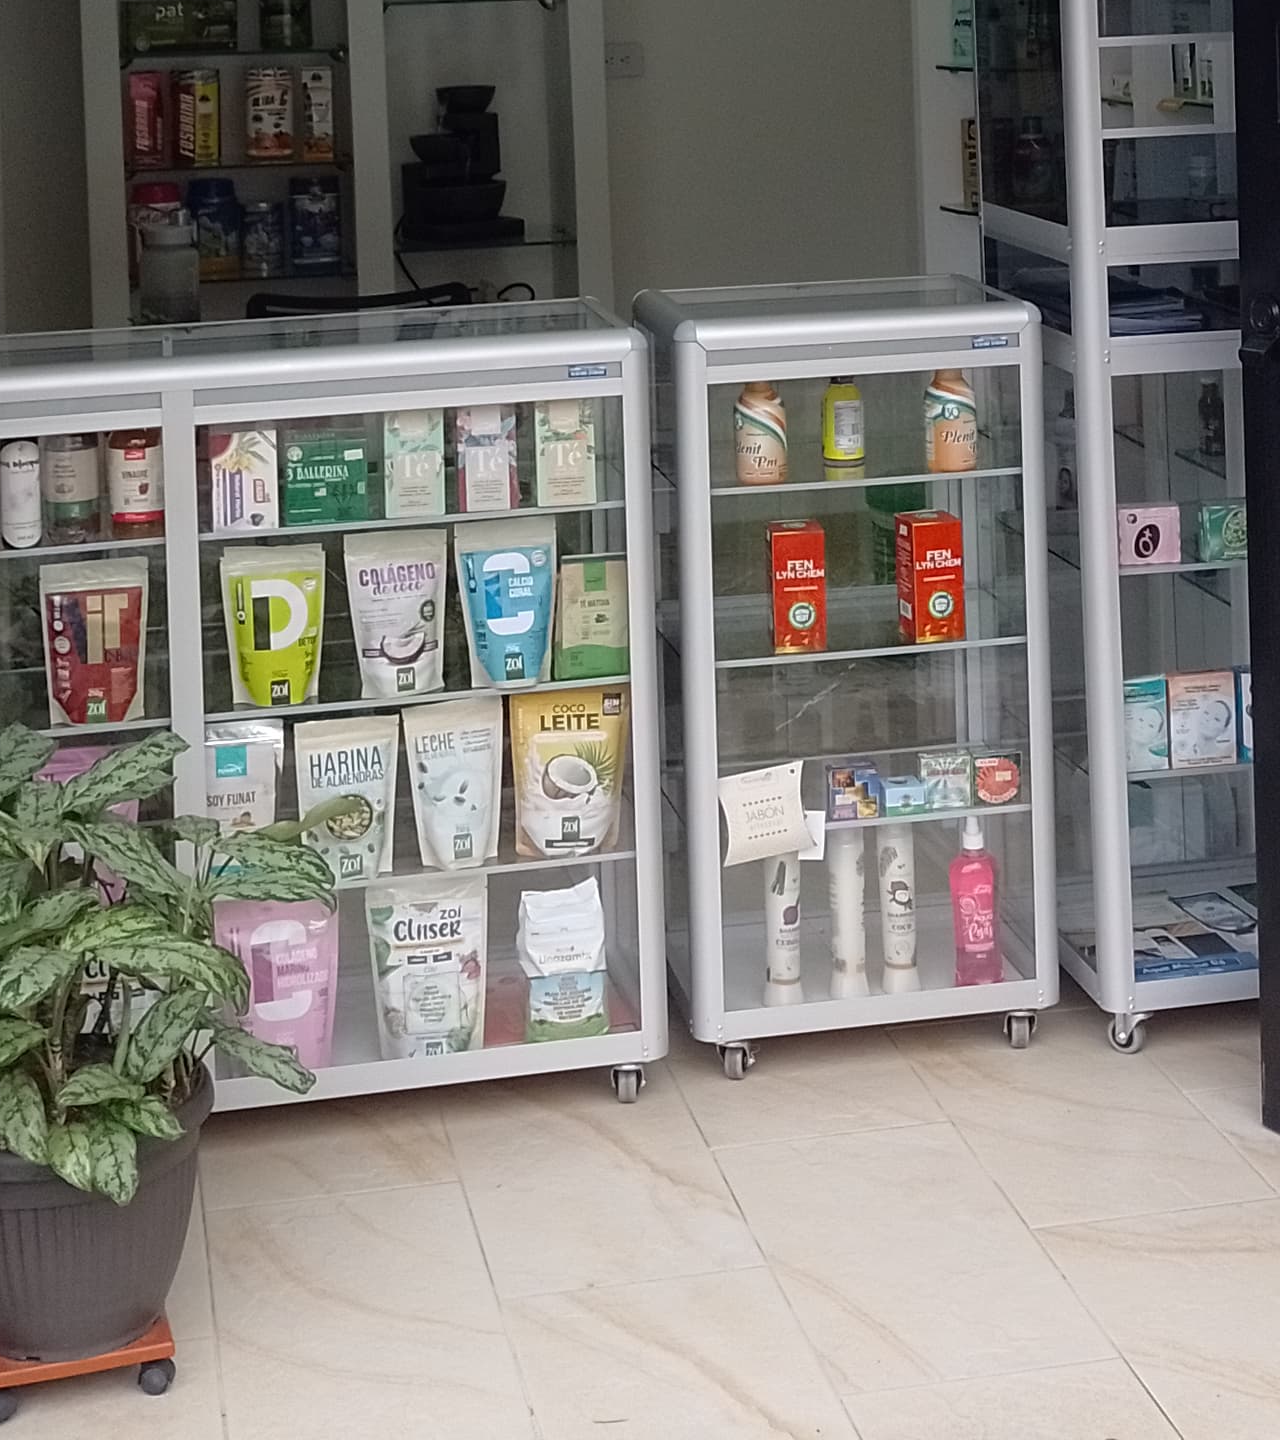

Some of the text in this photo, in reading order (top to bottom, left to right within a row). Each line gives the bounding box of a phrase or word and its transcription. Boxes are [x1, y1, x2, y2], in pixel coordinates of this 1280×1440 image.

[736, 442, 762, 455] lenit
[926, 549, 951, 560] FEN
[787, 560, 813, 570] FEN
[359, 563, 435, 587] COLÁGENO
[553, 704, 585, 713] COCO
[540, 713, 599, 731] LEITE
[415, 732, 455, 755] LECHE
[310, 746, 383, 779] HARINA
[207, 791, 256, 807] SOY FUNAT
